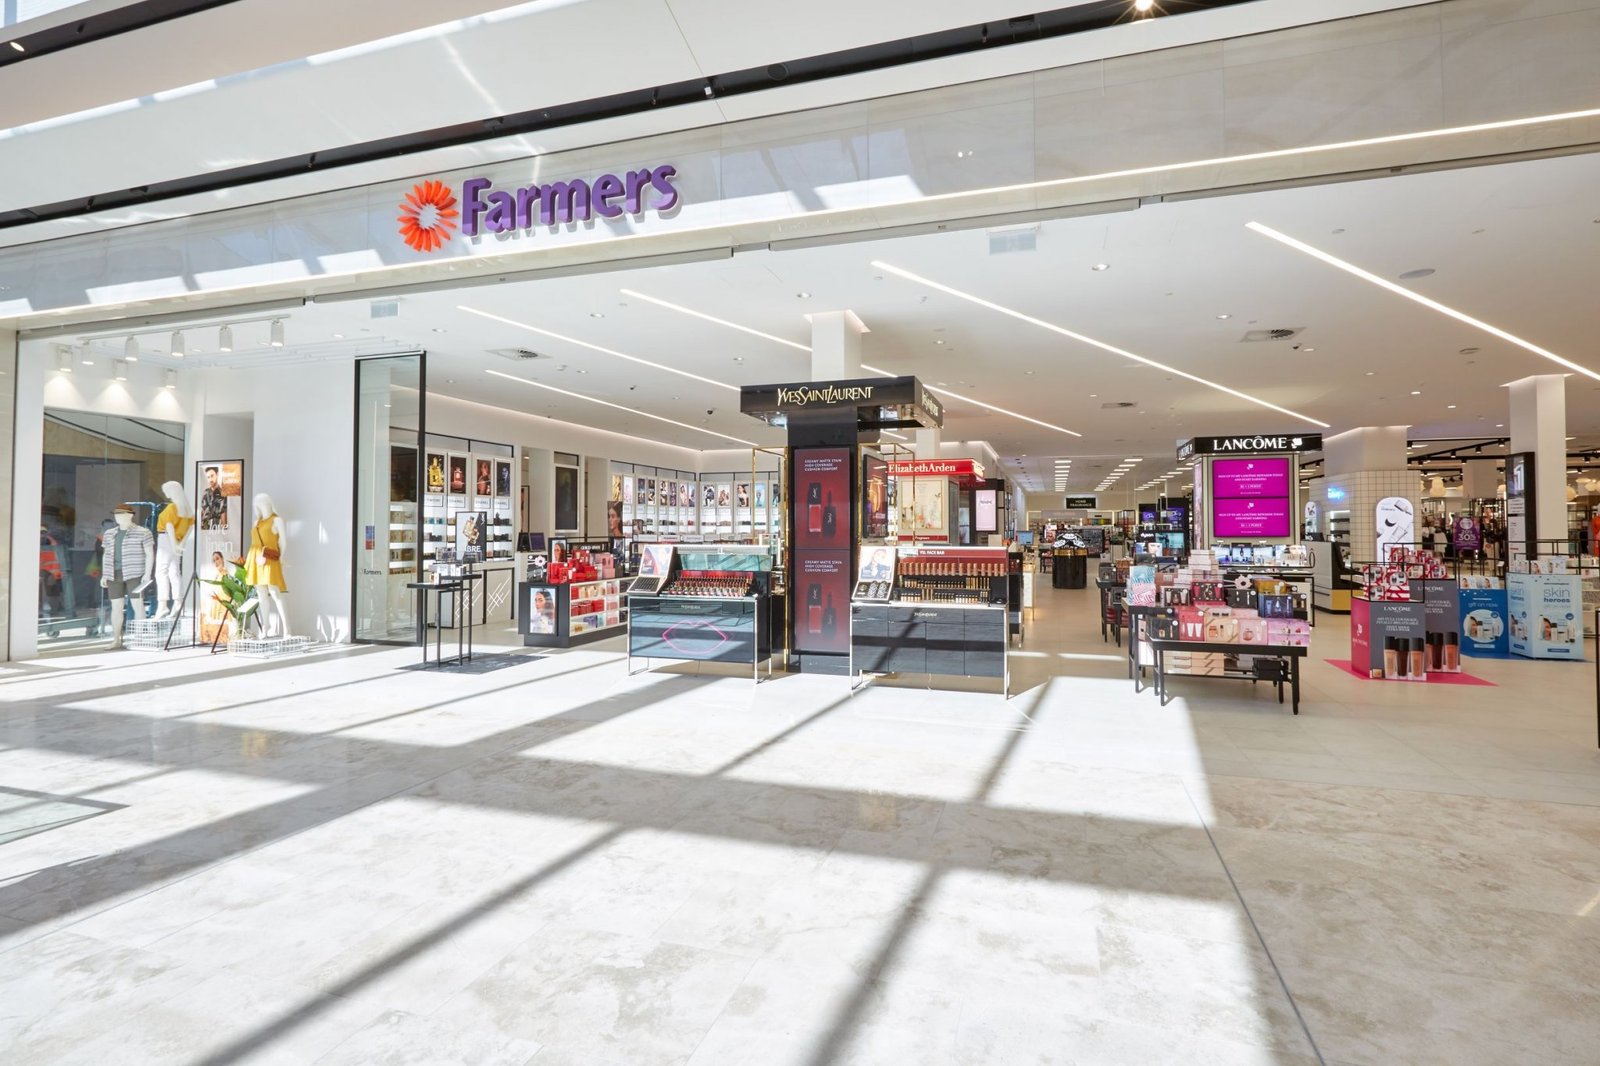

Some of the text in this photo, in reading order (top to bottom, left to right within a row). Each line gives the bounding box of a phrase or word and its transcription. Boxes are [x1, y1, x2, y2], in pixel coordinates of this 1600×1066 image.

[462, 165, 677, 236] Farmers
[1214, 435, 1287, 450] LANCÔME
[1544, 587, 1571, 597] skin
